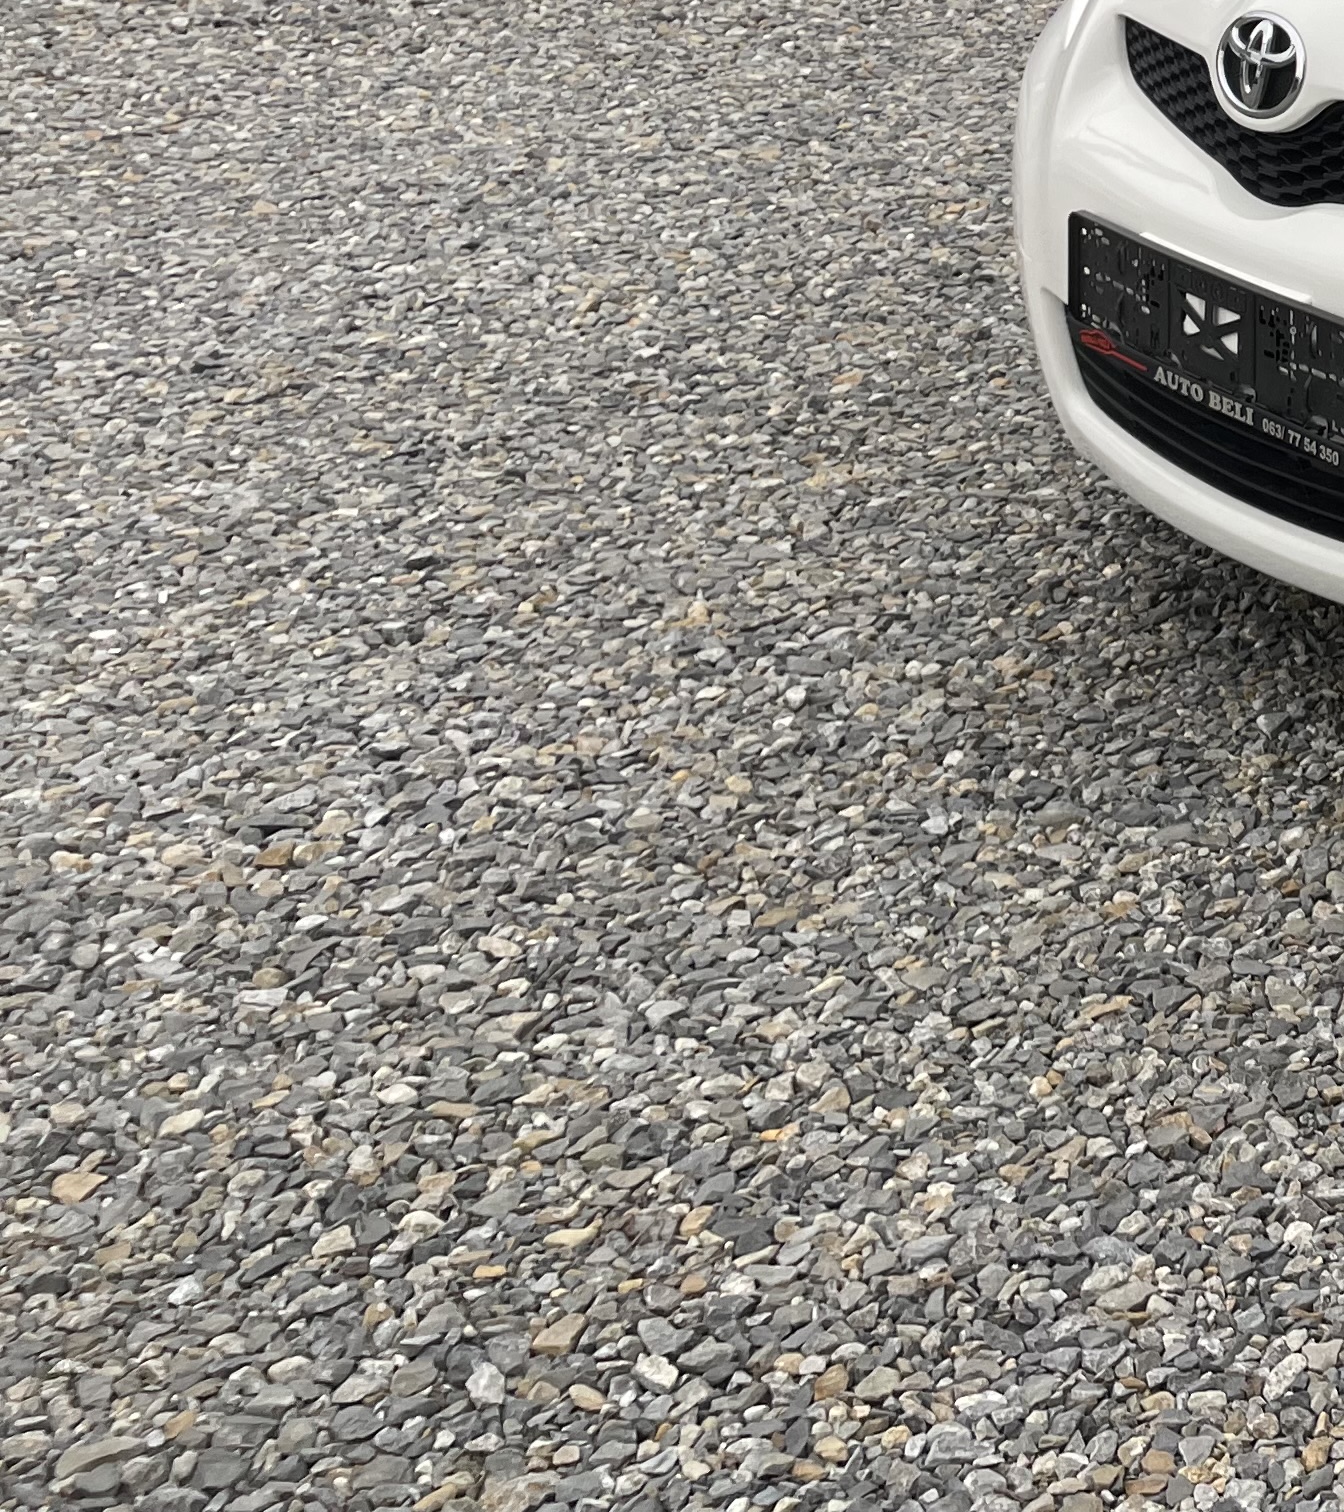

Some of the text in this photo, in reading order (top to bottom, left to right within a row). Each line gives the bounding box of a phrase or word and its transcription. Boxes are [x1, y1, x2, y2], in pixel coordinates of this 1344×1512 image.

[1153, 366, 1339, 466] AUTO BELI 063/ 77 54 350
